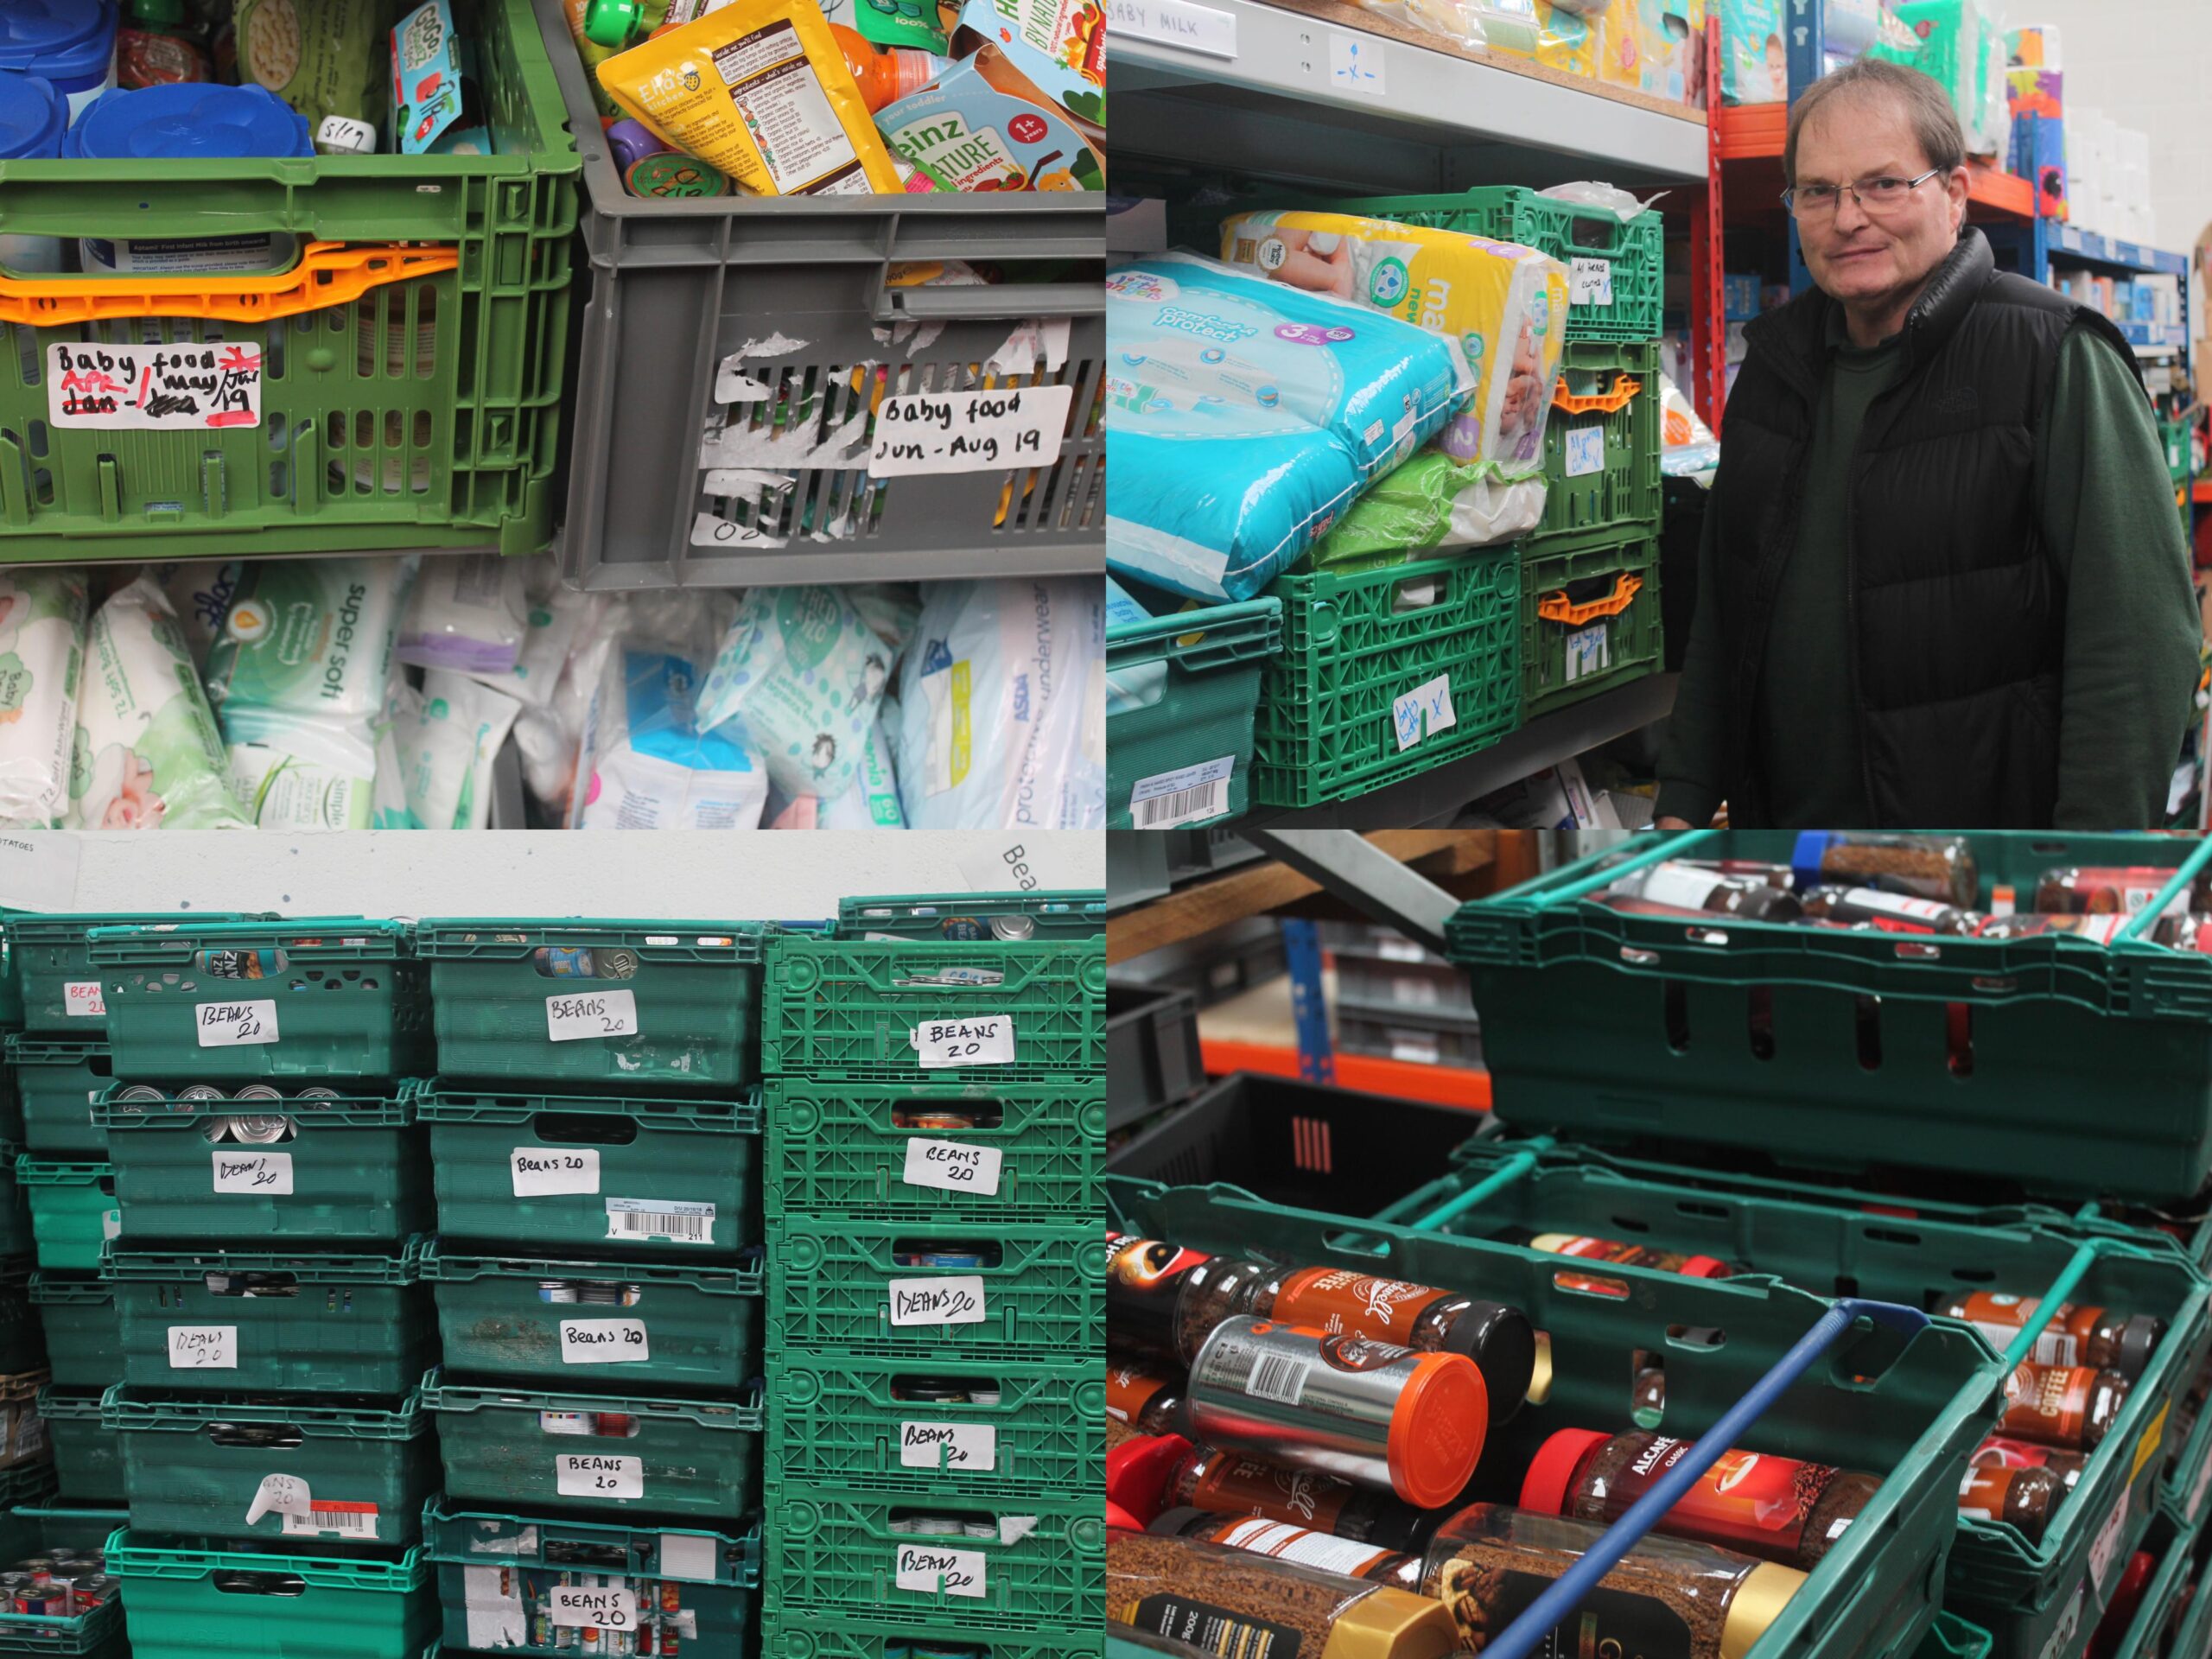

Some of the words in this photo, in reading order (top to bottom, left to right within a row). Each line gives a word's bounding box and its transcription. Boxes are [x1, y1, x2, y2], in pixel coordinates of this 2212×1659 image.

[1160, 13, 1198, 36] MILK
[906, 94, 947, 111] toddler
[896, 119, 965, 158] einz
[1024, 128, 1044, 142] years
[929, 135, 999, 180] ATURE
[955, 157, 1004, 188] ingredients
[1154, 312, 1240, 344] protect
[1281, 324, 1308, 340] 3
[58, 346, 137, 385] Baby
[152, 351, 216, 378] food
[886, 398, 951, 429] Baby
[966, 391, 1021, 417] food
[875, 442, 925, 461] Jun
[950, 435, 999, 461] Aug
[1015, 429, 1039, 452] 19
[338, 582, 367, 645] super
[1013, 672, 1030, 722] ASDA
[1002, 844, 1040, 893] Bea
[202, 1006, 255, 1027] BEANS
[552, 999, 606, 1019] BEANS
[237, 1021, 261, 1039] 20
[601, 1018, 625, 1032] 20
[930, 1022, 998, 1043] BEANS
[948, 1043, 981, 1058] 20
[517, 1157, 559, 1173] Beans
[564, 1156, 584, 1169] 20
[926, 1146, 981, 1166] BEANS
[251, 1171, 277, 1186] 20
[948, 1166, 974, 1180] 20
[945, 1291, 976, 1318] 20
[566, 1327, 615, 1344] Beans
[623, 1328, 644, 1344] 20
[195, 1348, 222, 1365] 20
[569, 1457, 622, 1471] BEANS
[595, 1476, 618, 1489] 20
[562, 1593, 620, 1609] BEANS
[592, 1611, 626, 1625] 20
[1180, 1610, 1198, 1641] 200g
